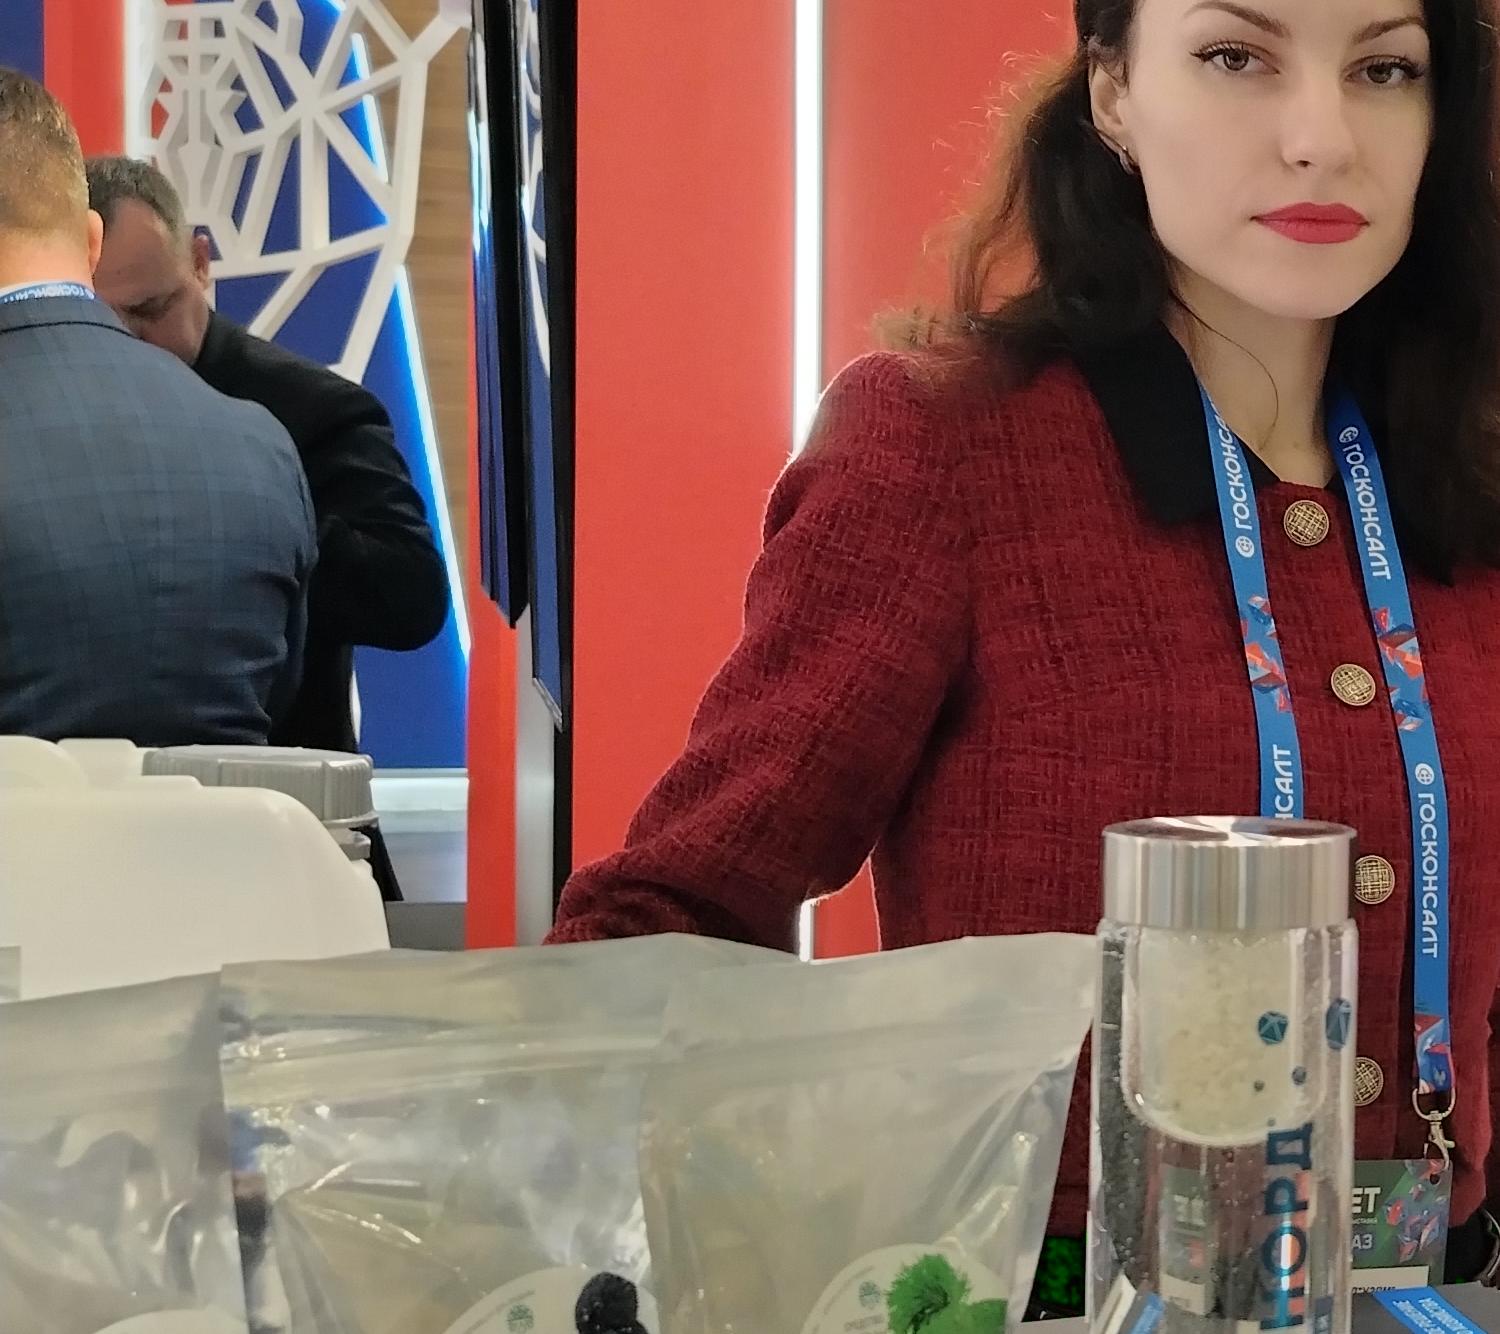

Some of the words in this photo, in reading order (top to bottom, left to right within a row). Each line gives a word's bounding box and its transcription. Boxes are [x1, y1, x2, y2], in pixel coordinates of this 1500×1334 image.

[1213, 412, 1253, 531] ГОСКОНСА
[1342, 443, 1391, 581] ГОСКОНСАЛТ
[1417, 792, 1440, 959] ГОСКОНСАЛТ
